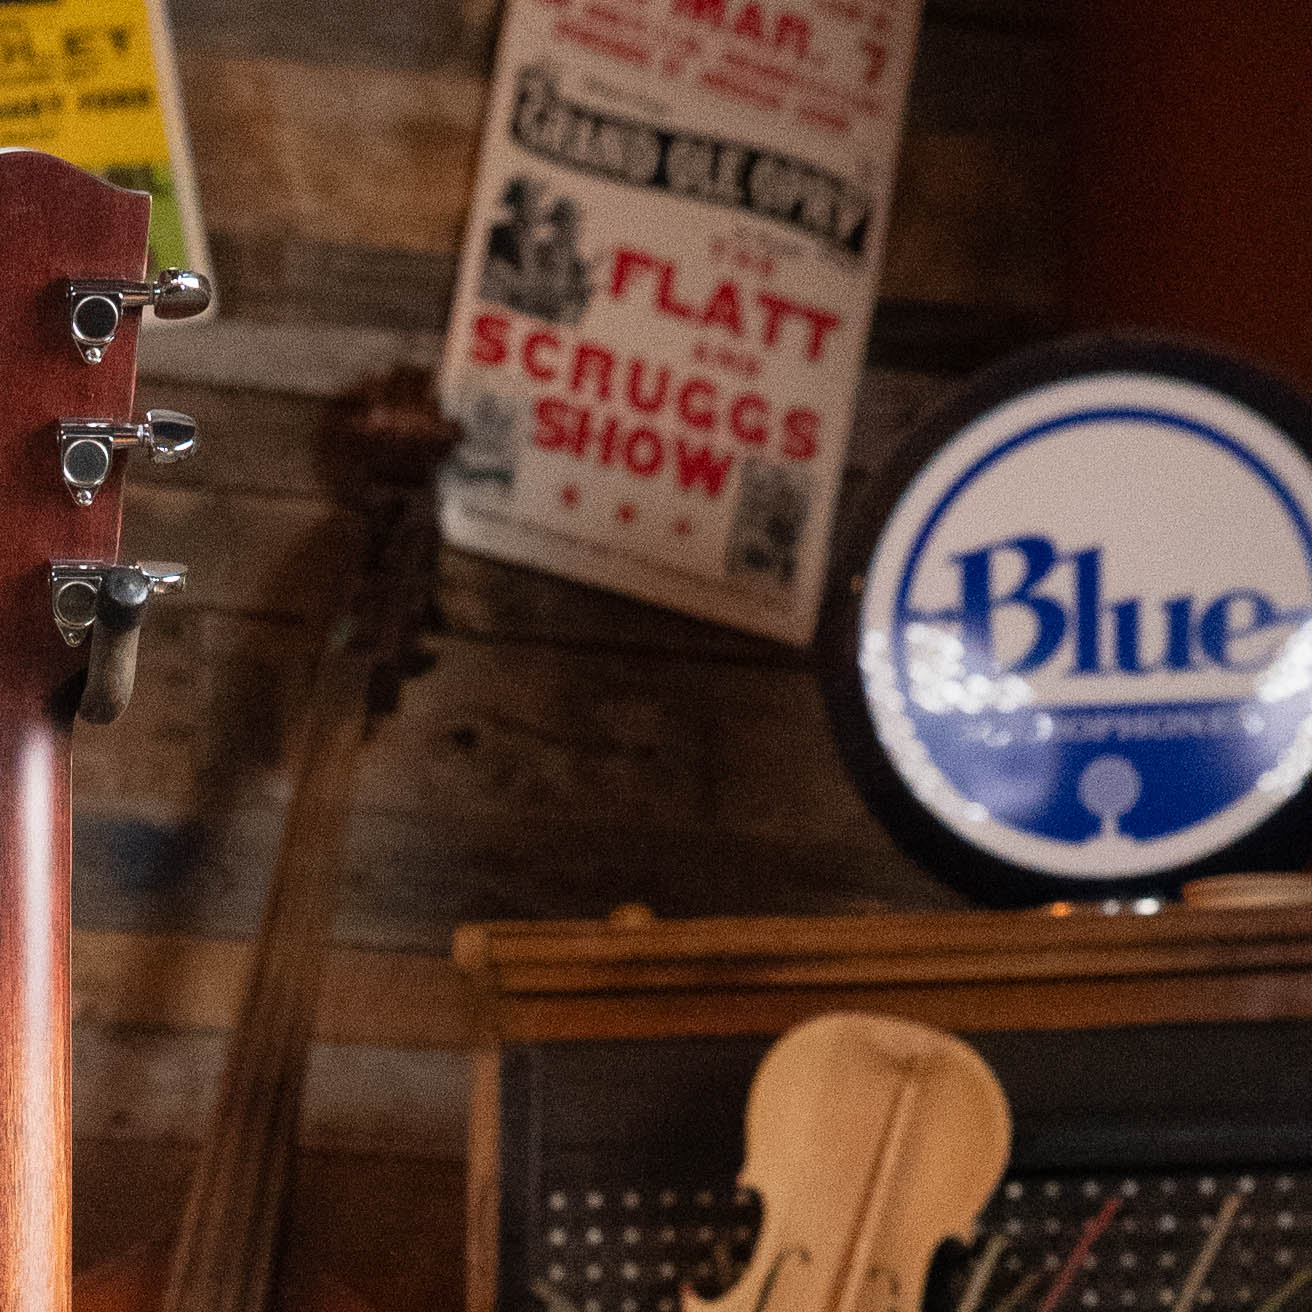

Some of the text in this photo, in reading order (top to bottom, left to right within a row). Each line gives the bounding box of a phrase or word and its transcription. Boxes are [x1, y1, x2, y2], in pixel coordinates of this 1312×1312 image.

[610, 247, 841, 362] FLATT
[470, 313, 822, 462] SCRUGGS
[532, 397, 736, 500] SHOW
[949, 533, 1294, 679] Blue
